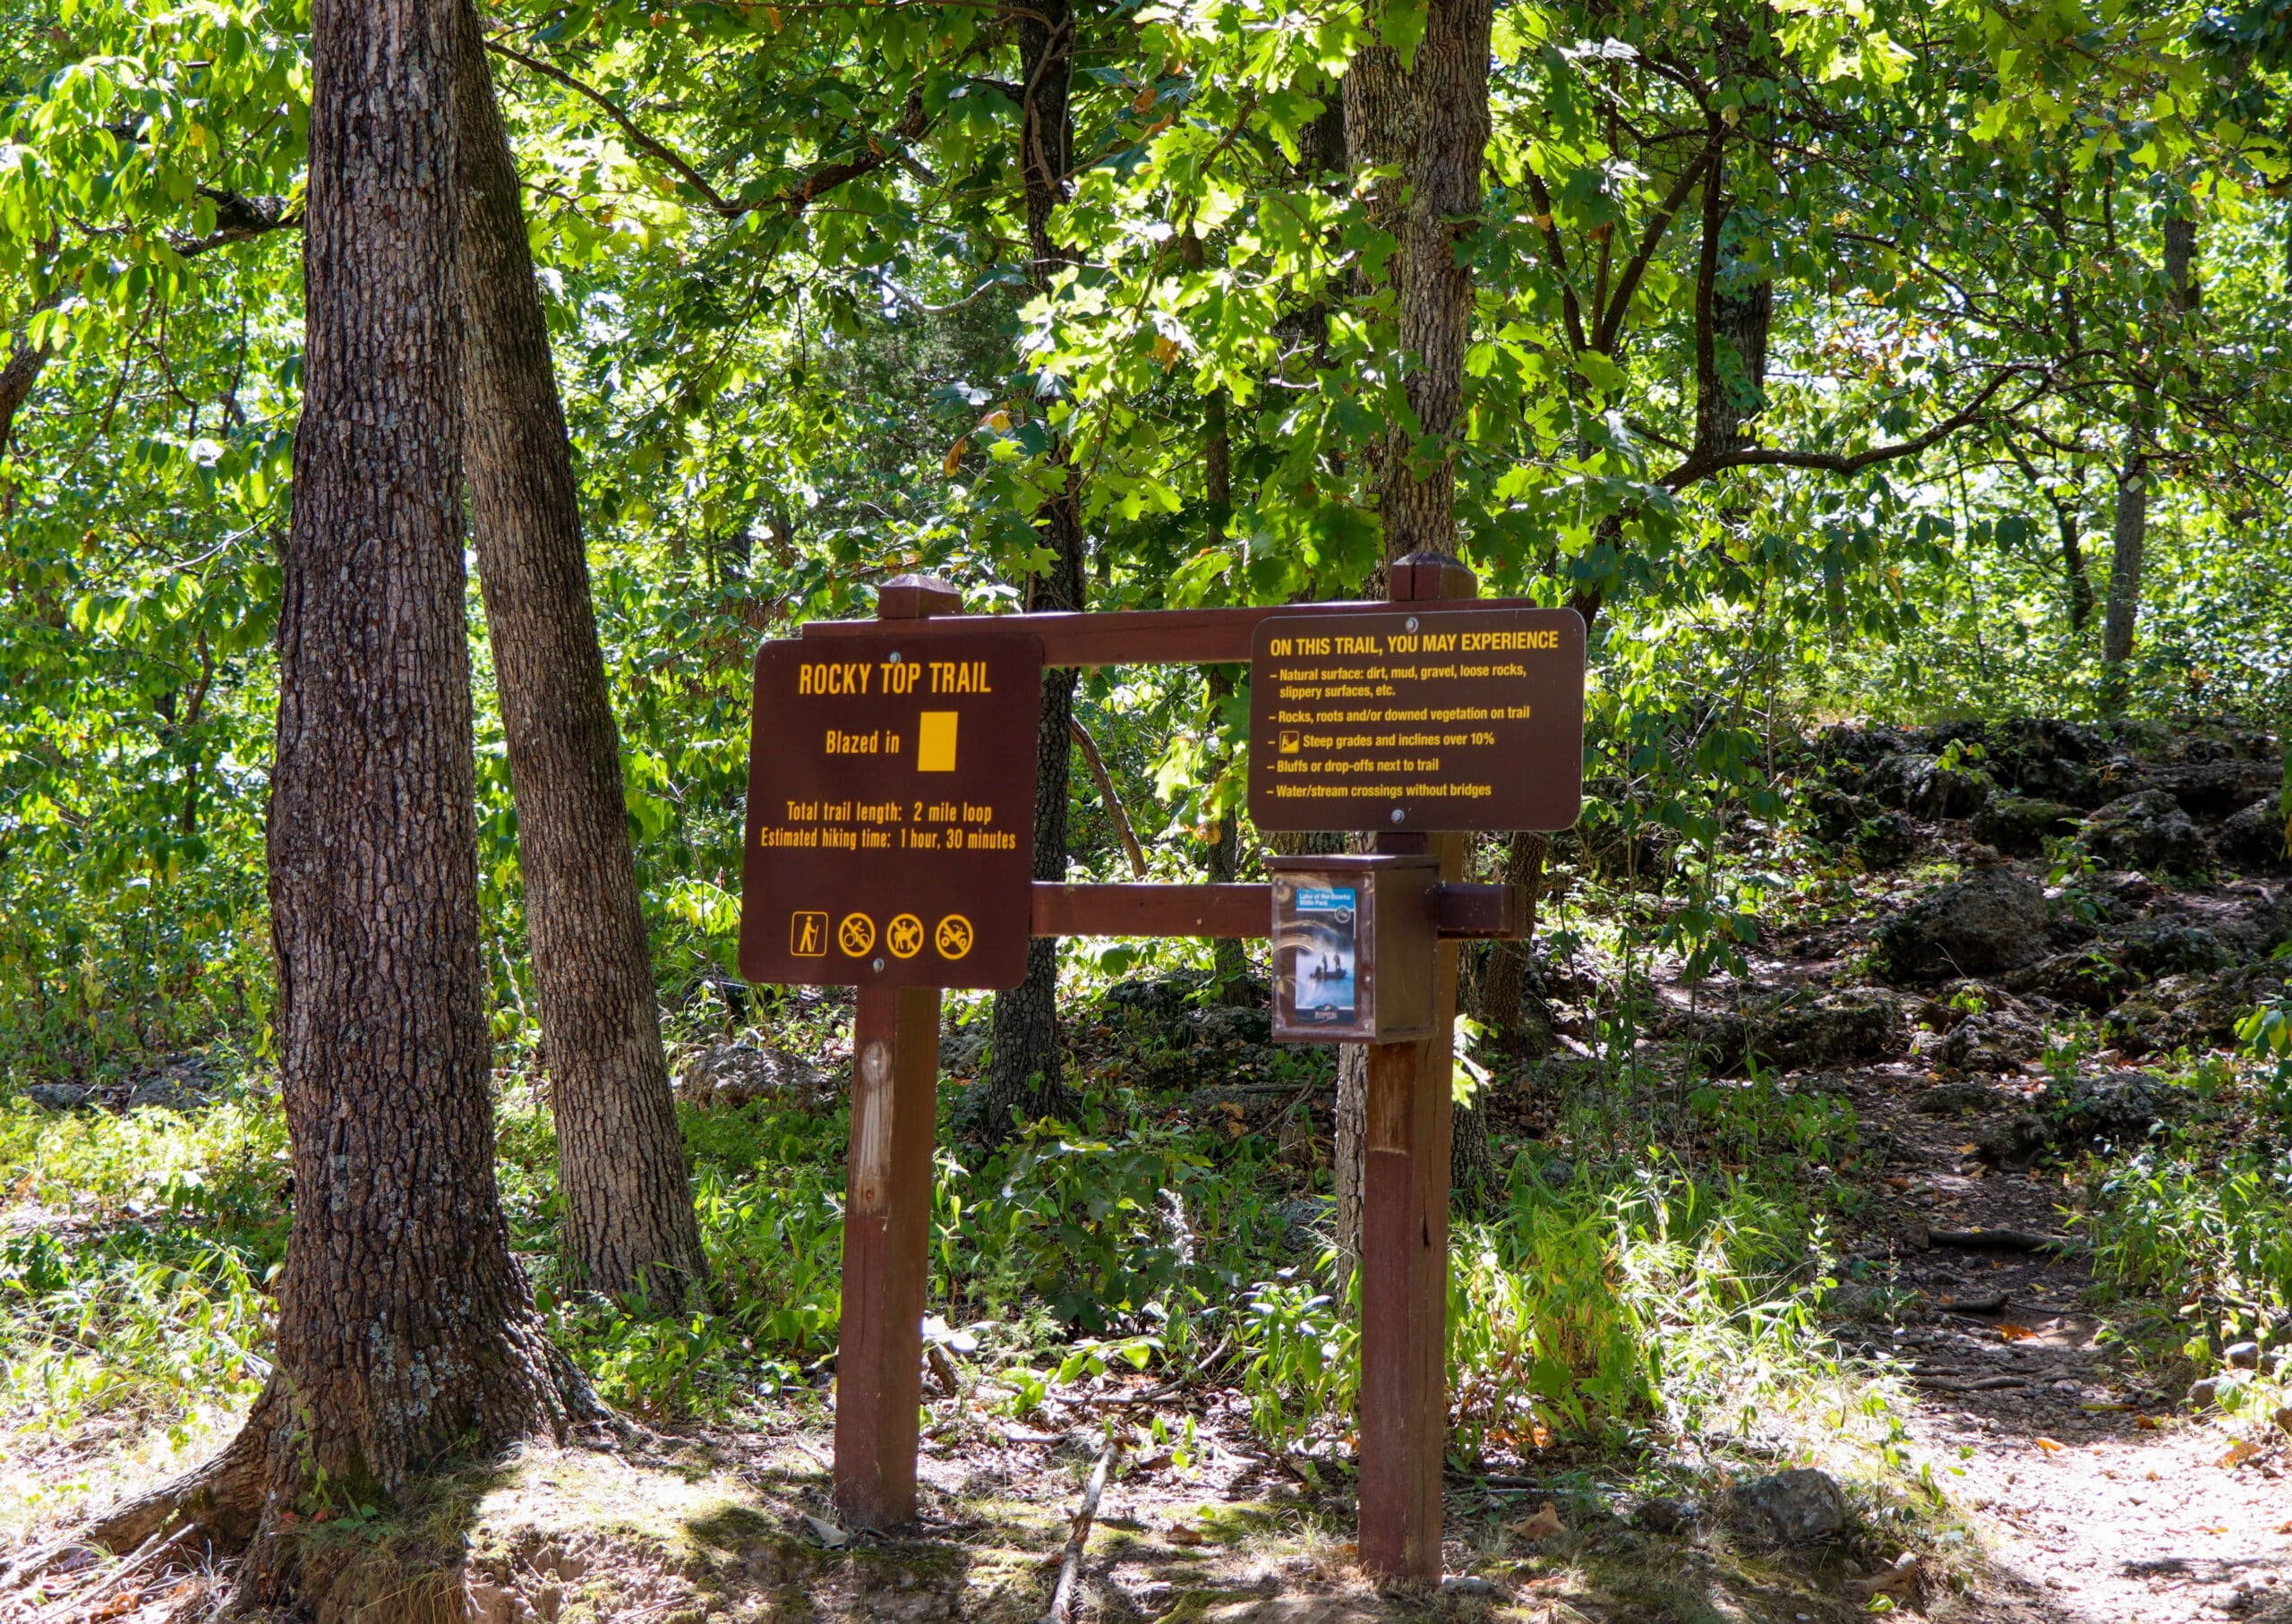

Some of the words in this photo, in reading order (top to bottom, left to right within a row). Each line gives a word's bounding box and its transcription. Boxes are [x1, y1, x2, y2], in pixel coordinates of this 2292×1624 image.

[1270, 637, 1293, 657] ON
[1295, 637, 1331, 656] THIS
[1333, 635, 1384, 657] TRAIL,
[1386, 633, 1419, 654] YOU
[1422, 632, 1458, 653] MAY
[1460, 629, 1560, 652] EXPERIENCE
[799, 662, 872, 695] ROCKY
[879, 662, 921, 694] TOP
[928, 661, 992, 694] TRAIL
[1279, 668, 1319, 682] Natural
[1320, 666, 1364, 681] surface:
[1365, 665, 1389, 681] dirt,
[1390, 666, 1419, 681] mud,
[1420, 663, 1458, 681] gravel,
[1459, 663, 1491, 678] loose
[1492, 662, 1527, 678] rocks,
[1279, 685, 1321, 701] slippery
[1324, 684, 1373, 698] surfaces,
[1375, 683, 1397, 697] etc.
[1278, 710, 1314, 725] Rocks,
[1315, 709, 1345, 723] roots
[1346, 708, 1381, 723] and/or
[1384, 708, 1427, 722] downed
[1430, 705, 1489, 722] vegetation
[1490, 708, 1505, 720] on
[1507, 705, 1532, 720] trail
[825, 730, 879, 754] Blazed
[885, 730, 900, 754] in
[1303, 734, 1333, 749] Steep
[1336, 734, 1373, 749] grades
[1375, 733, 1396, 747] and
[1398, 731, 1441, 747] inclines
[1442, 732, 1467, 746] over
[1470, 731, 1495, 746] 10%
[1277, 759, 1308, 774] Bluffs
[1310, 761, 1322, 773] or
[1324, 759, 1374, 774] drop-offs
[1376, 758, 1401, 772] next
[1403, 759, 1415, 772] to
[1416, 757, 1440, 772] trail
[1276, 784, 1349, 799] Water/stream
[1350, 784, 1404, 799] crossings
[1405, 783, 1449, 797] without
[1450, 782, 1492, 799] bridges
[786, 800, 818, 821] Total
[823, 801, 851, 822] trail
[856, 801, 902, 825] length:
[912, 800, 923, 822] 2
[928, 801, 957, 822] mile
[962, 801, 992, 826] loop
[760, 826, 818, 848] Estimated
[821, 827, 857, 851] hiking
[861, 828, 892, 849] time:
[901, 827, 906, 849] 1
[910, 827, 941, 850] hour,
[945, 828, 963, 850] 30
[967, 829, 1016, 850] minutes
